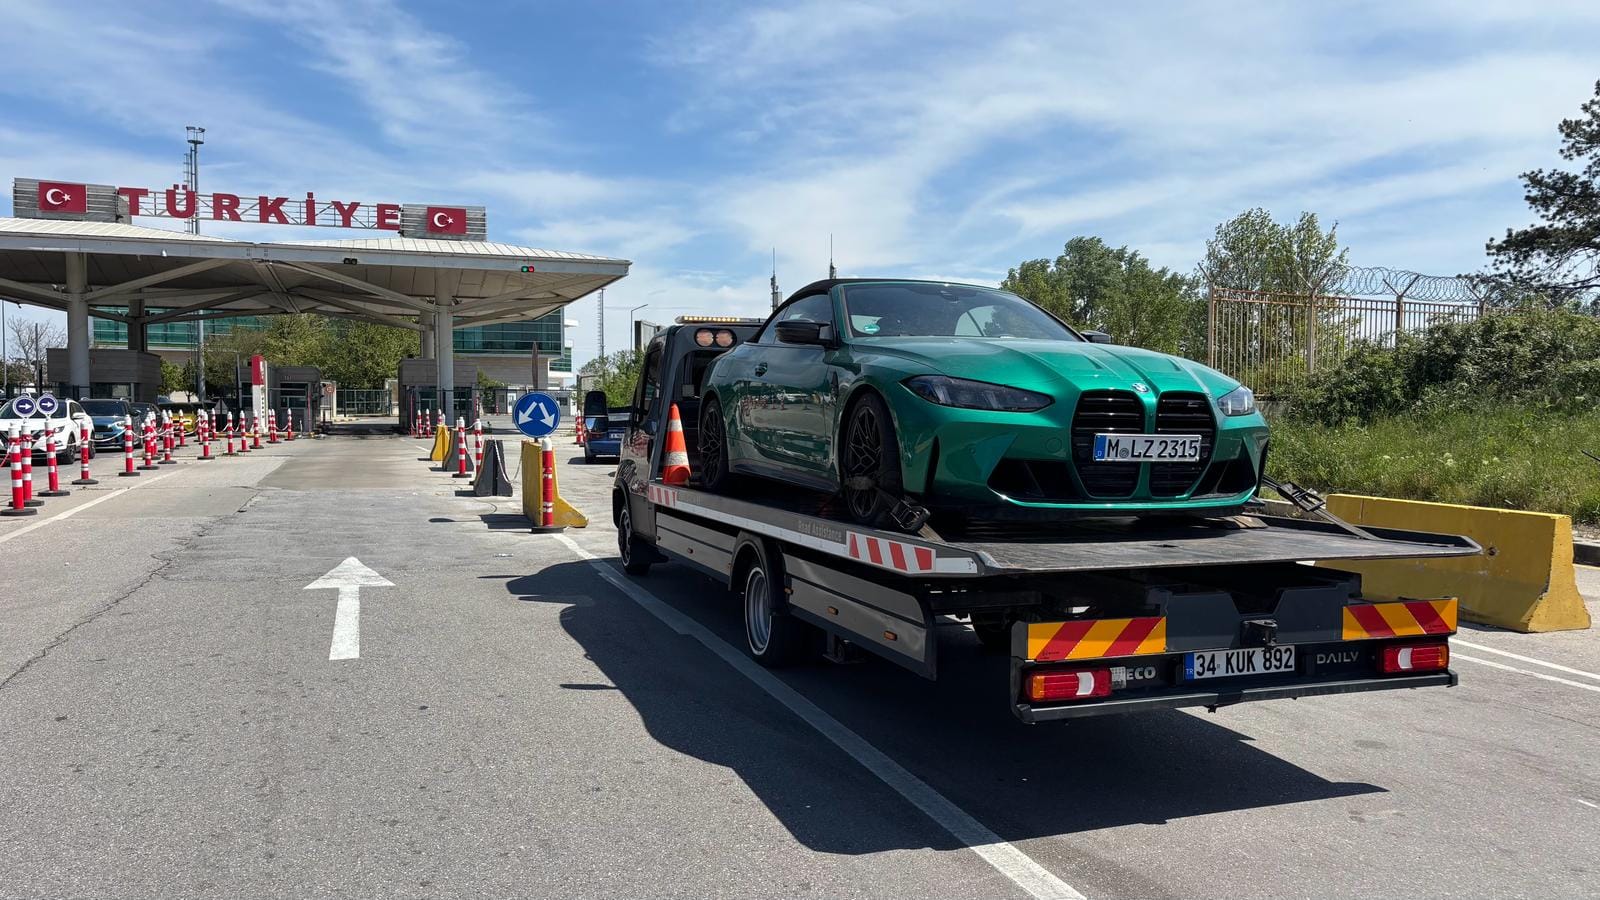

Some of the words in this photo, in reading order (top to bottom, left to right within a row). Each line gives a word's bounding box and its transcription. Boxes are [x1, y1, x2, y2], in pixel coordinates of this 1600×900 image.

[118, 184, 401, 231] TÜRKİYE
[1106, 438, 1120, 458] M
[1131, 439, 1154, 458] LZ
[1157, 439, 1199, 458] 2315
[1196, 653, 1217, 677] 34
[1225, 651, 1256, 674] KUK
[1262, 647, 1293, 671] 892
[1316, 651, 1359, 664] DAILY
[1126, 666, 1156, 680] ECO
